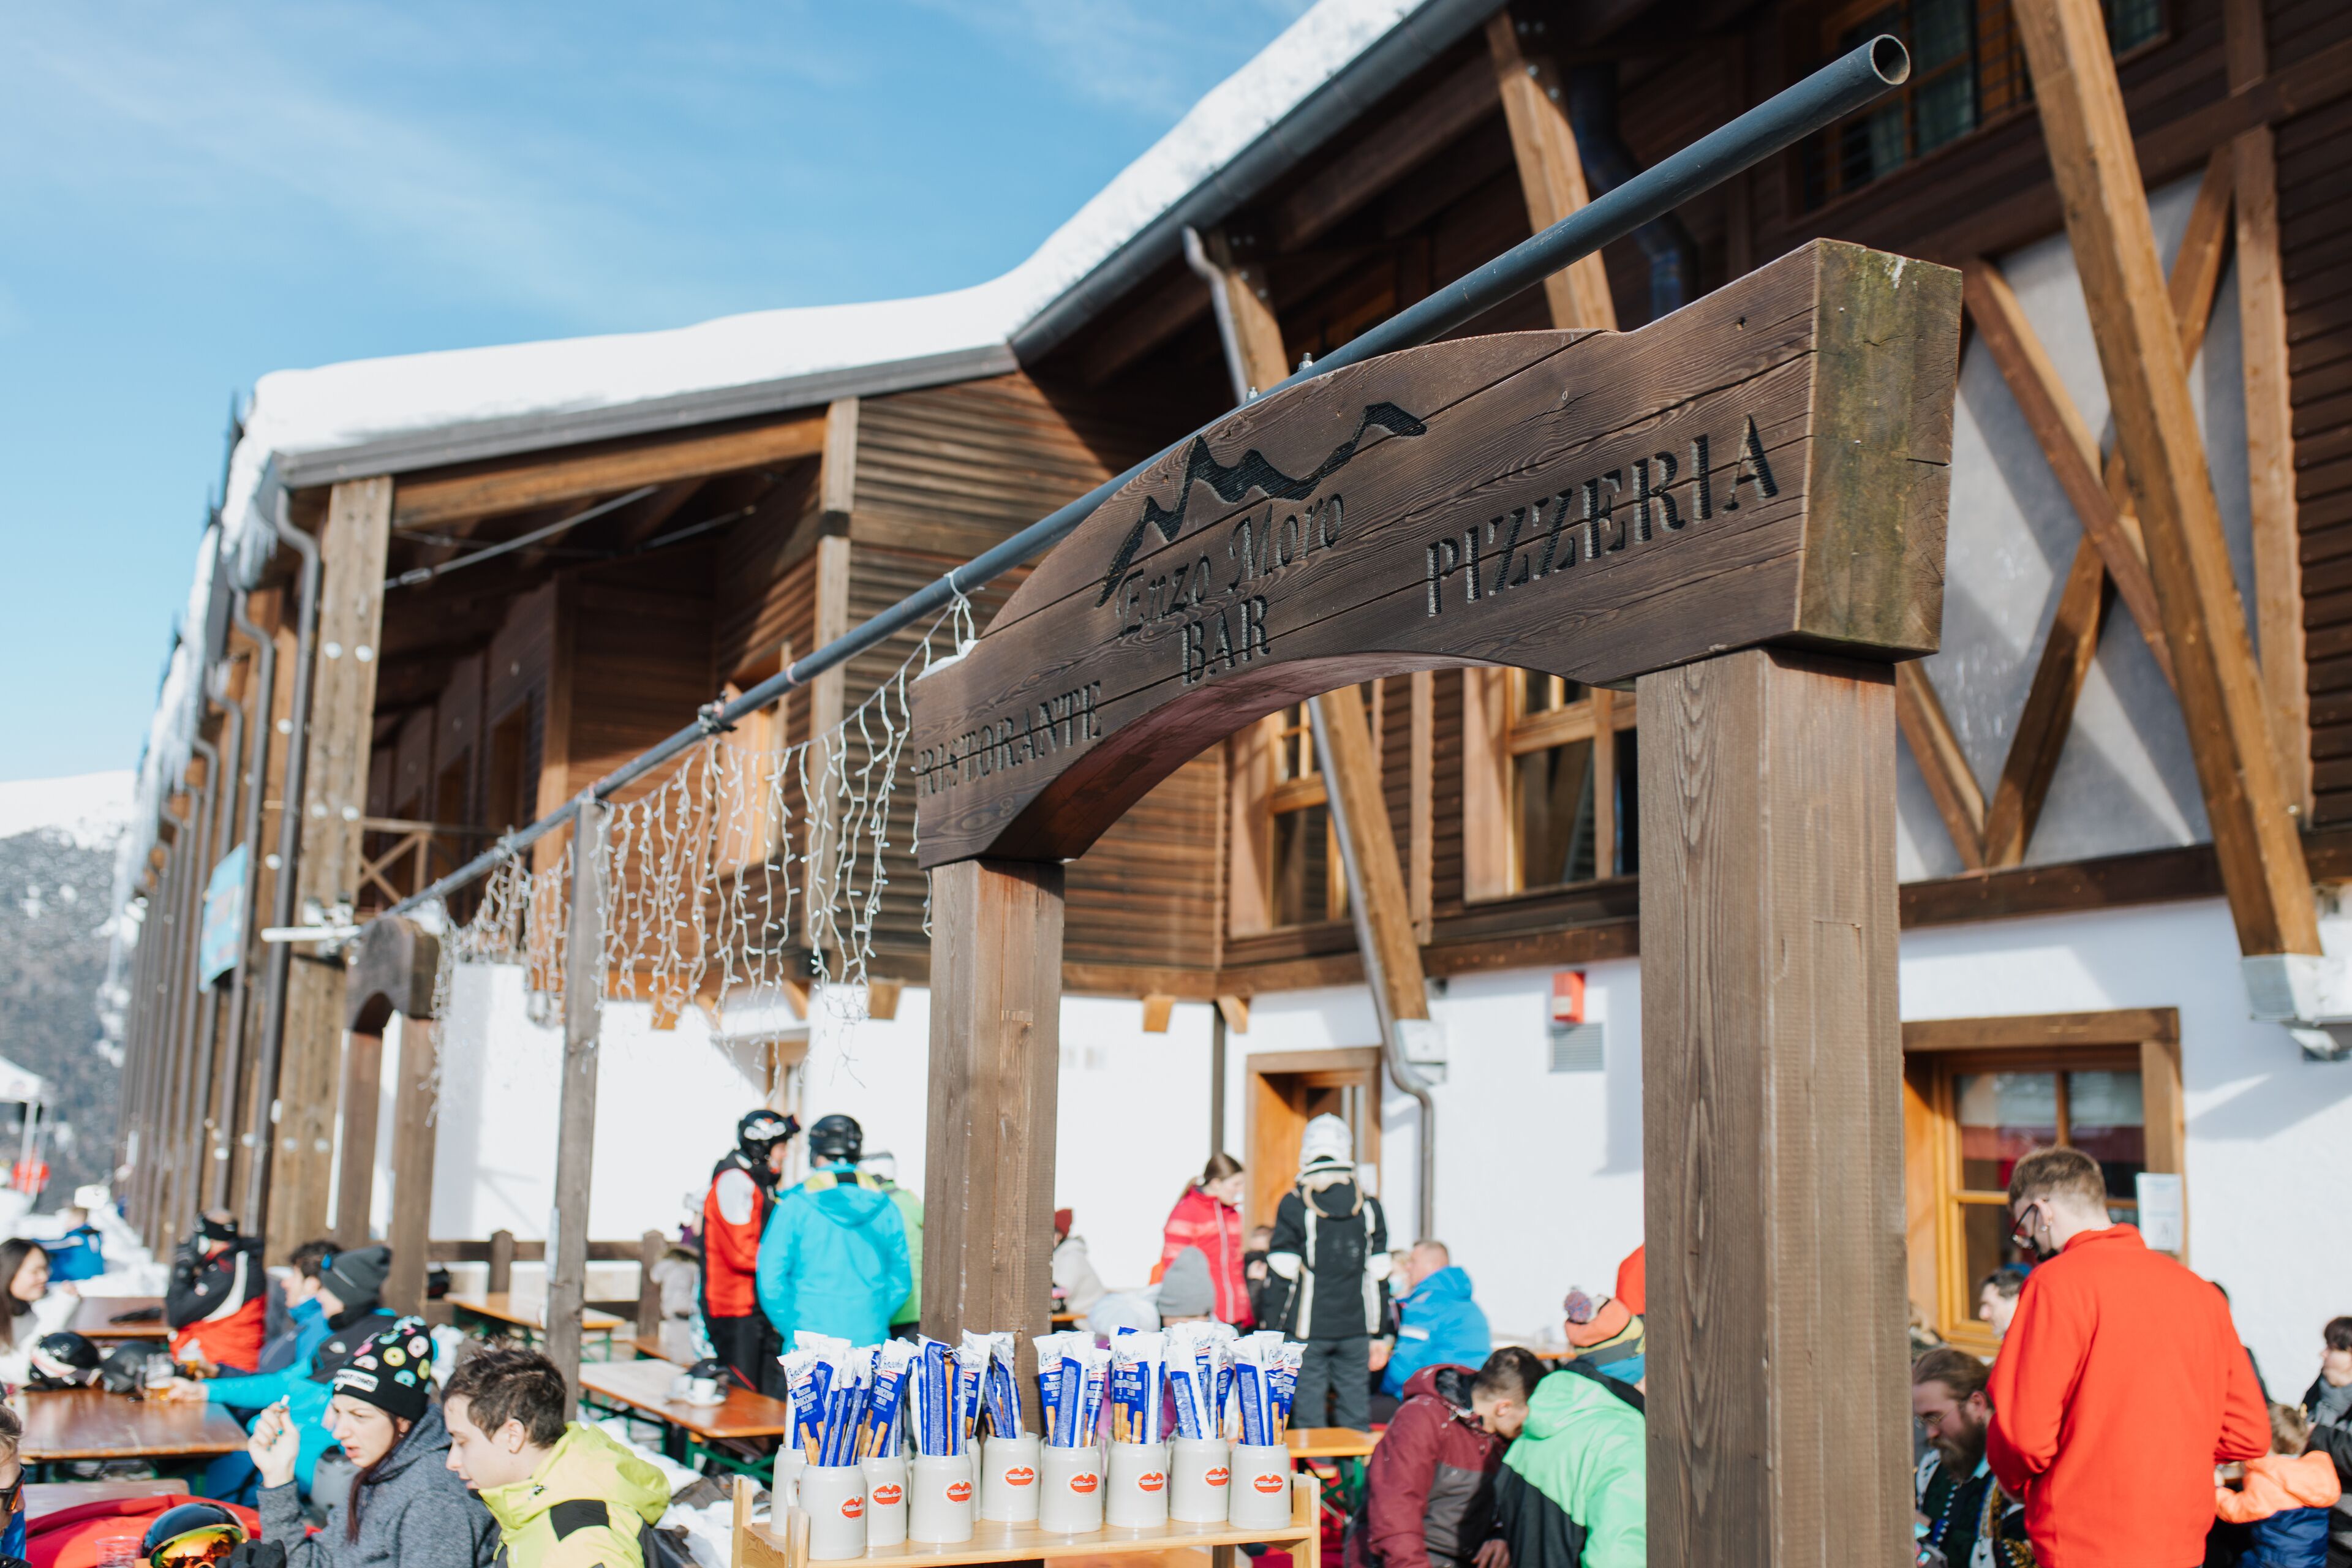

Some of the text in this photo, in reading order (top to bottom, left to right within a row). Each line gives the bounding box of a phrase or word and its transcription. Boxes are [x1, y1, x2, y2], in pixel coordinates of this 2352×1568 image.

[1116, 494, 1344, 639] Enzo Moro
[1427, 414, 1779, 617] PIZZERIA
[1182, 595, 1271, 685] BAR
[919, 680, 1102, 798] RISTORANTE
